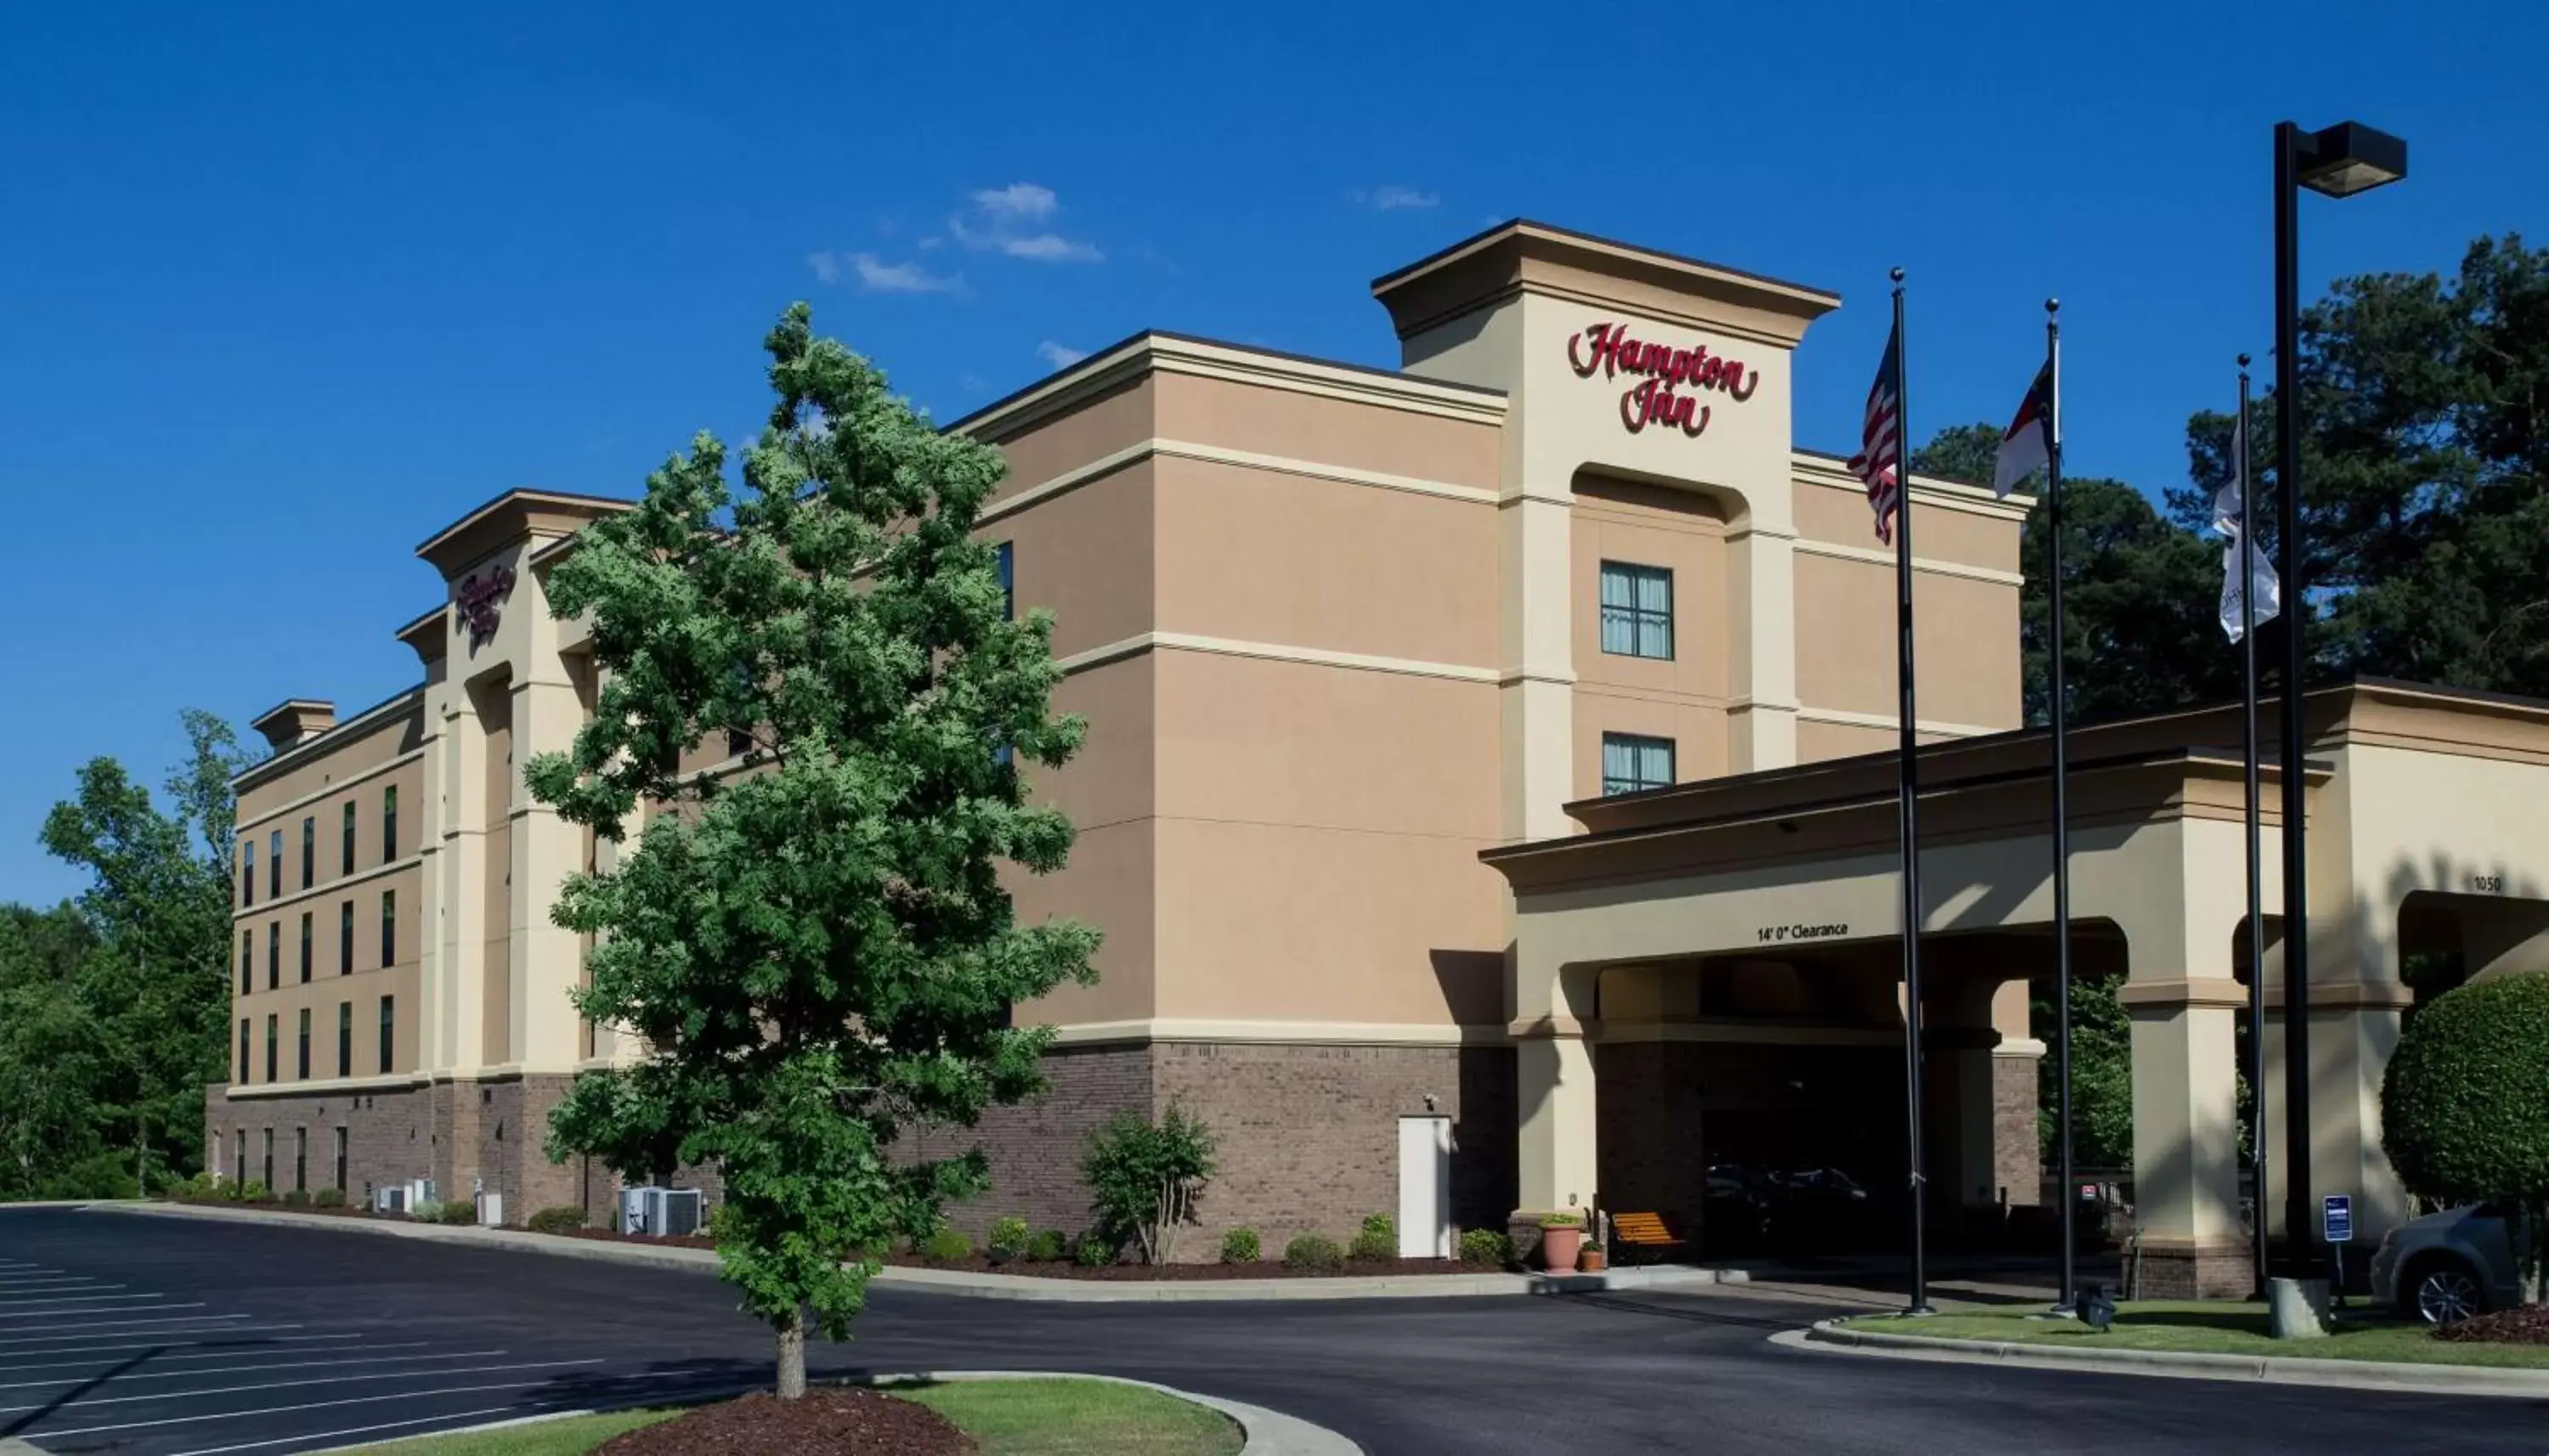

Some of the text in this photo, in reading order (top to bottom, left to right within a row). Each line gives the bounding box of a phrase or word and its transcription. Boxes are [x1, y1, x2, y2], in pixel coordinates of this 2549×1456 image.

[1568, 322, 1759, 403] Hampton
[1619, 378, 1710, 438] Inn
[2473, 876, 2501, 891] 1050
[1791, 923, 1848, 939] Clearance
